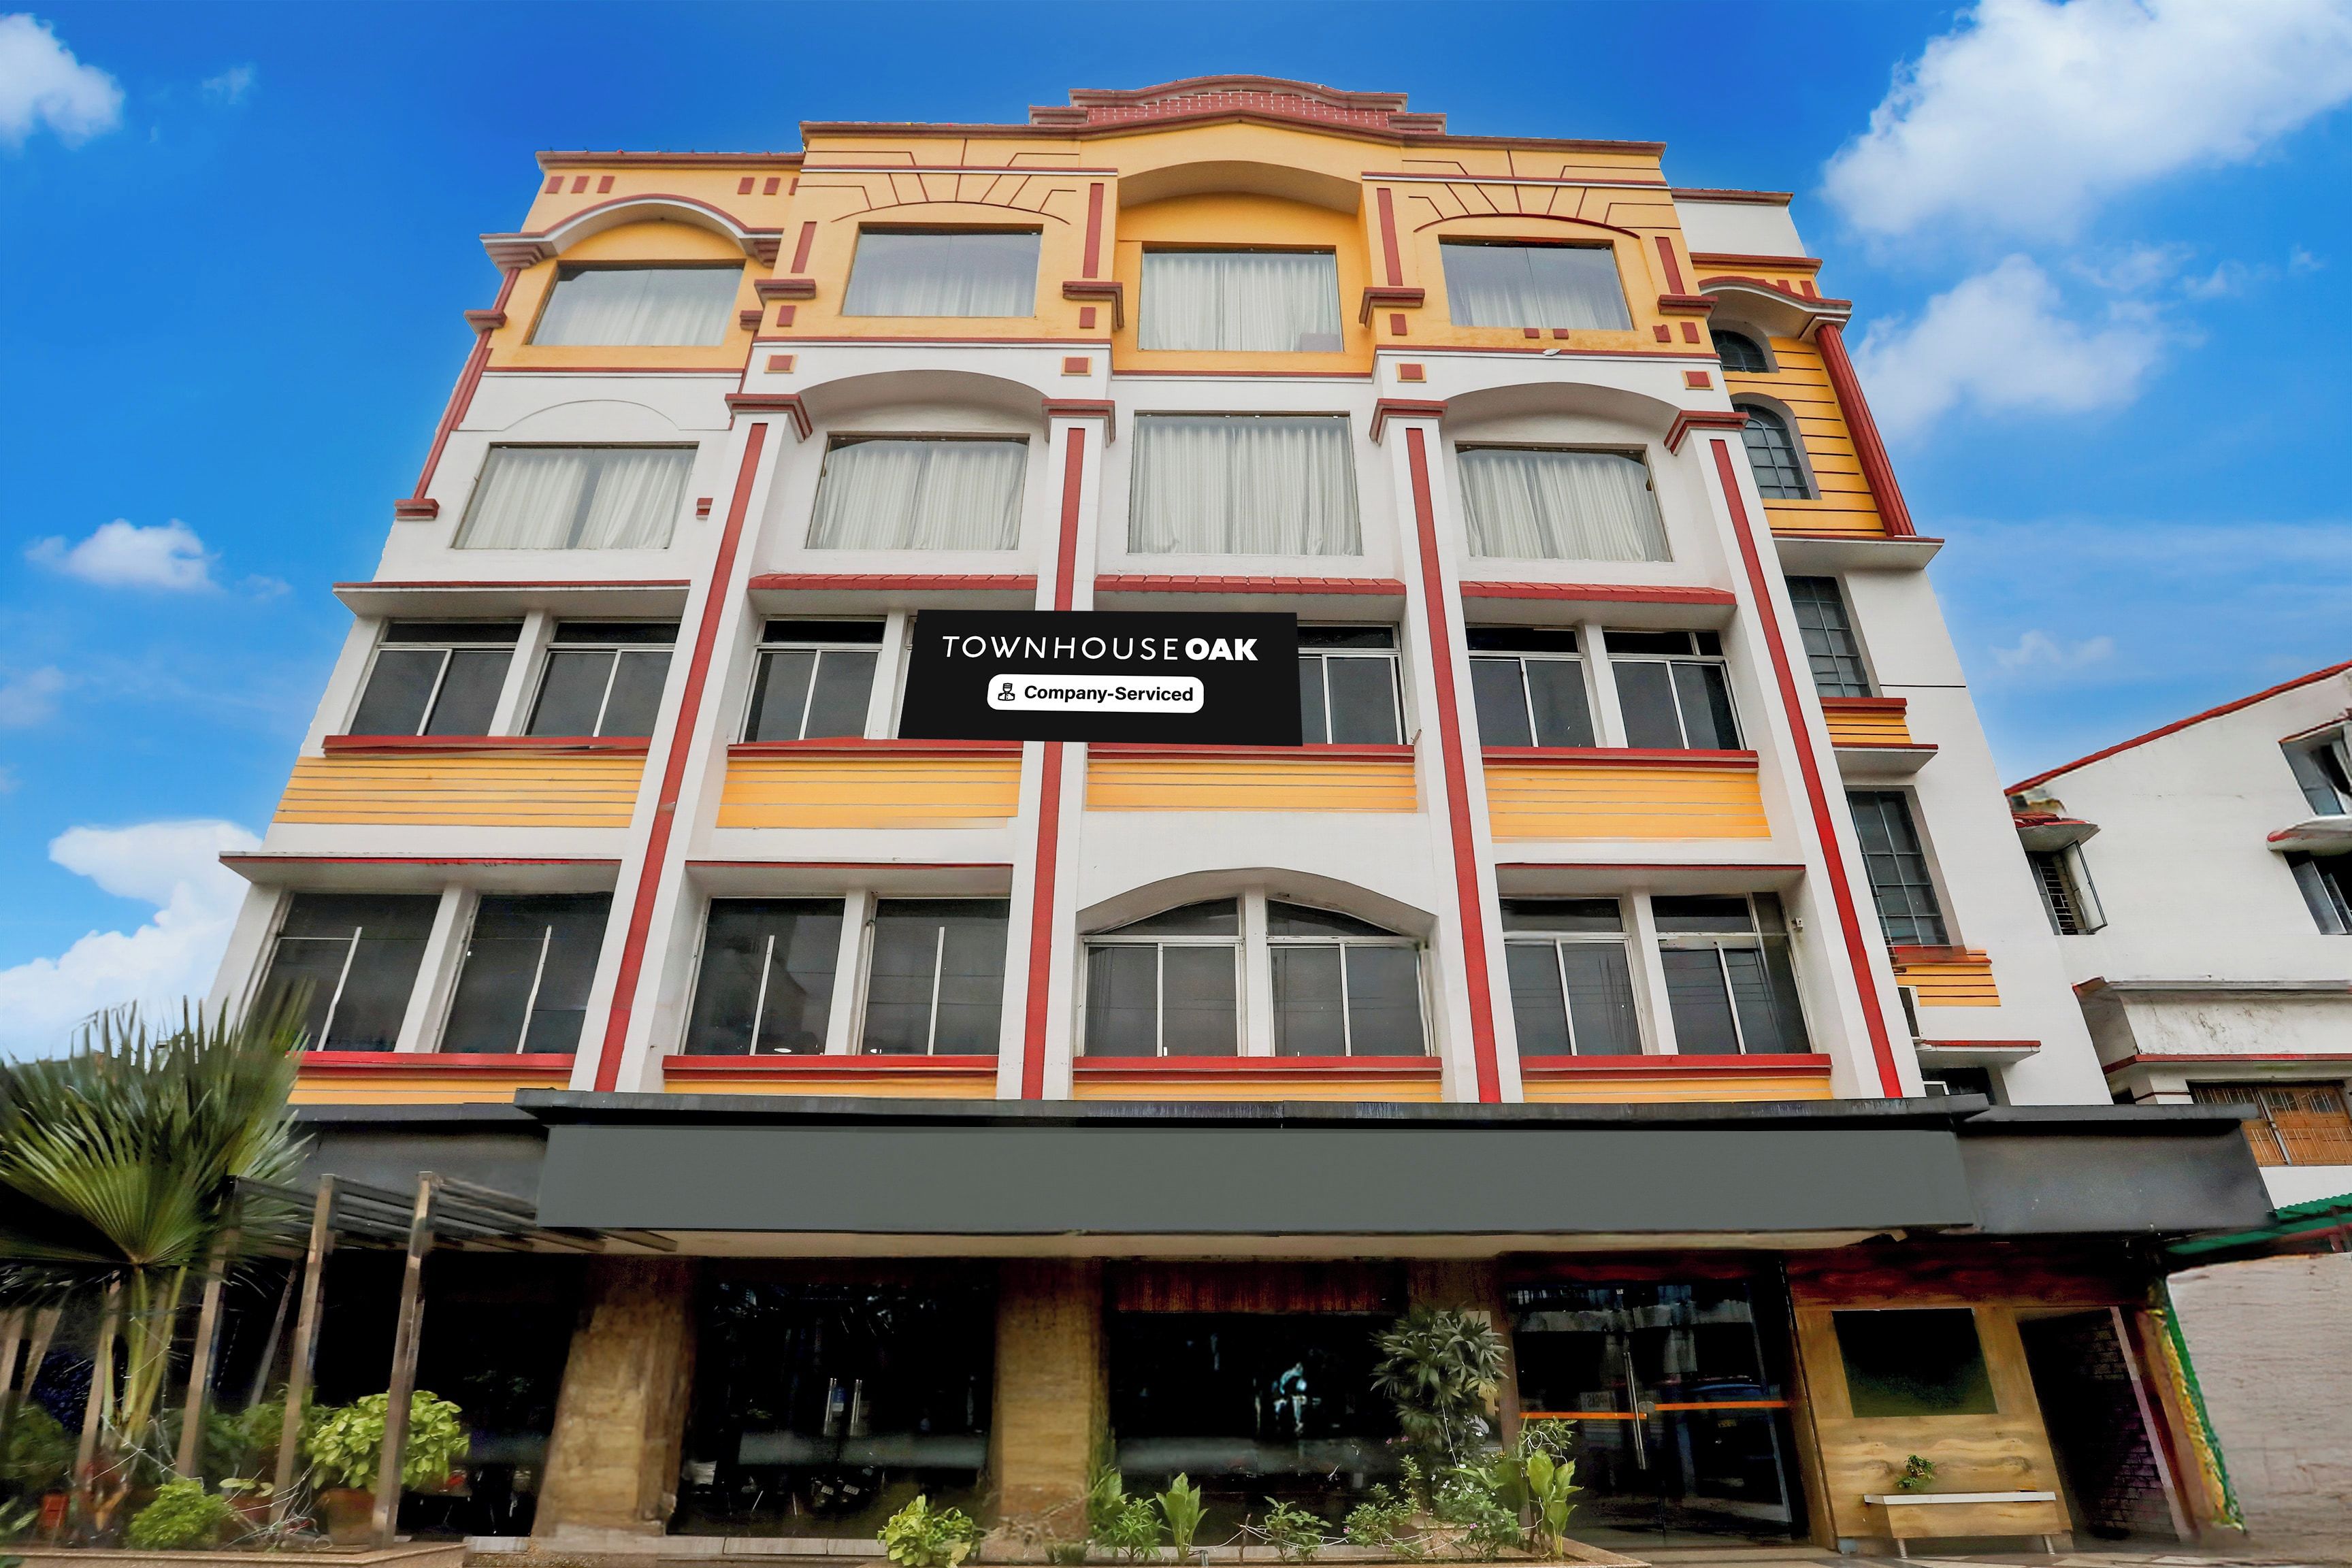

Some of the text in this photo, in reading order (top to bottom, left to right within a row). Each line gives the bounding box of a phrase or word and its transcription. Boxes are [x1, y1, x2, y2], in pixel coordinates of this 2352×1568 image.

[942, 636, 1259, 661] TOWNHOUSE OAK
[1024, 685, 1194, 702] Company-Serviced
